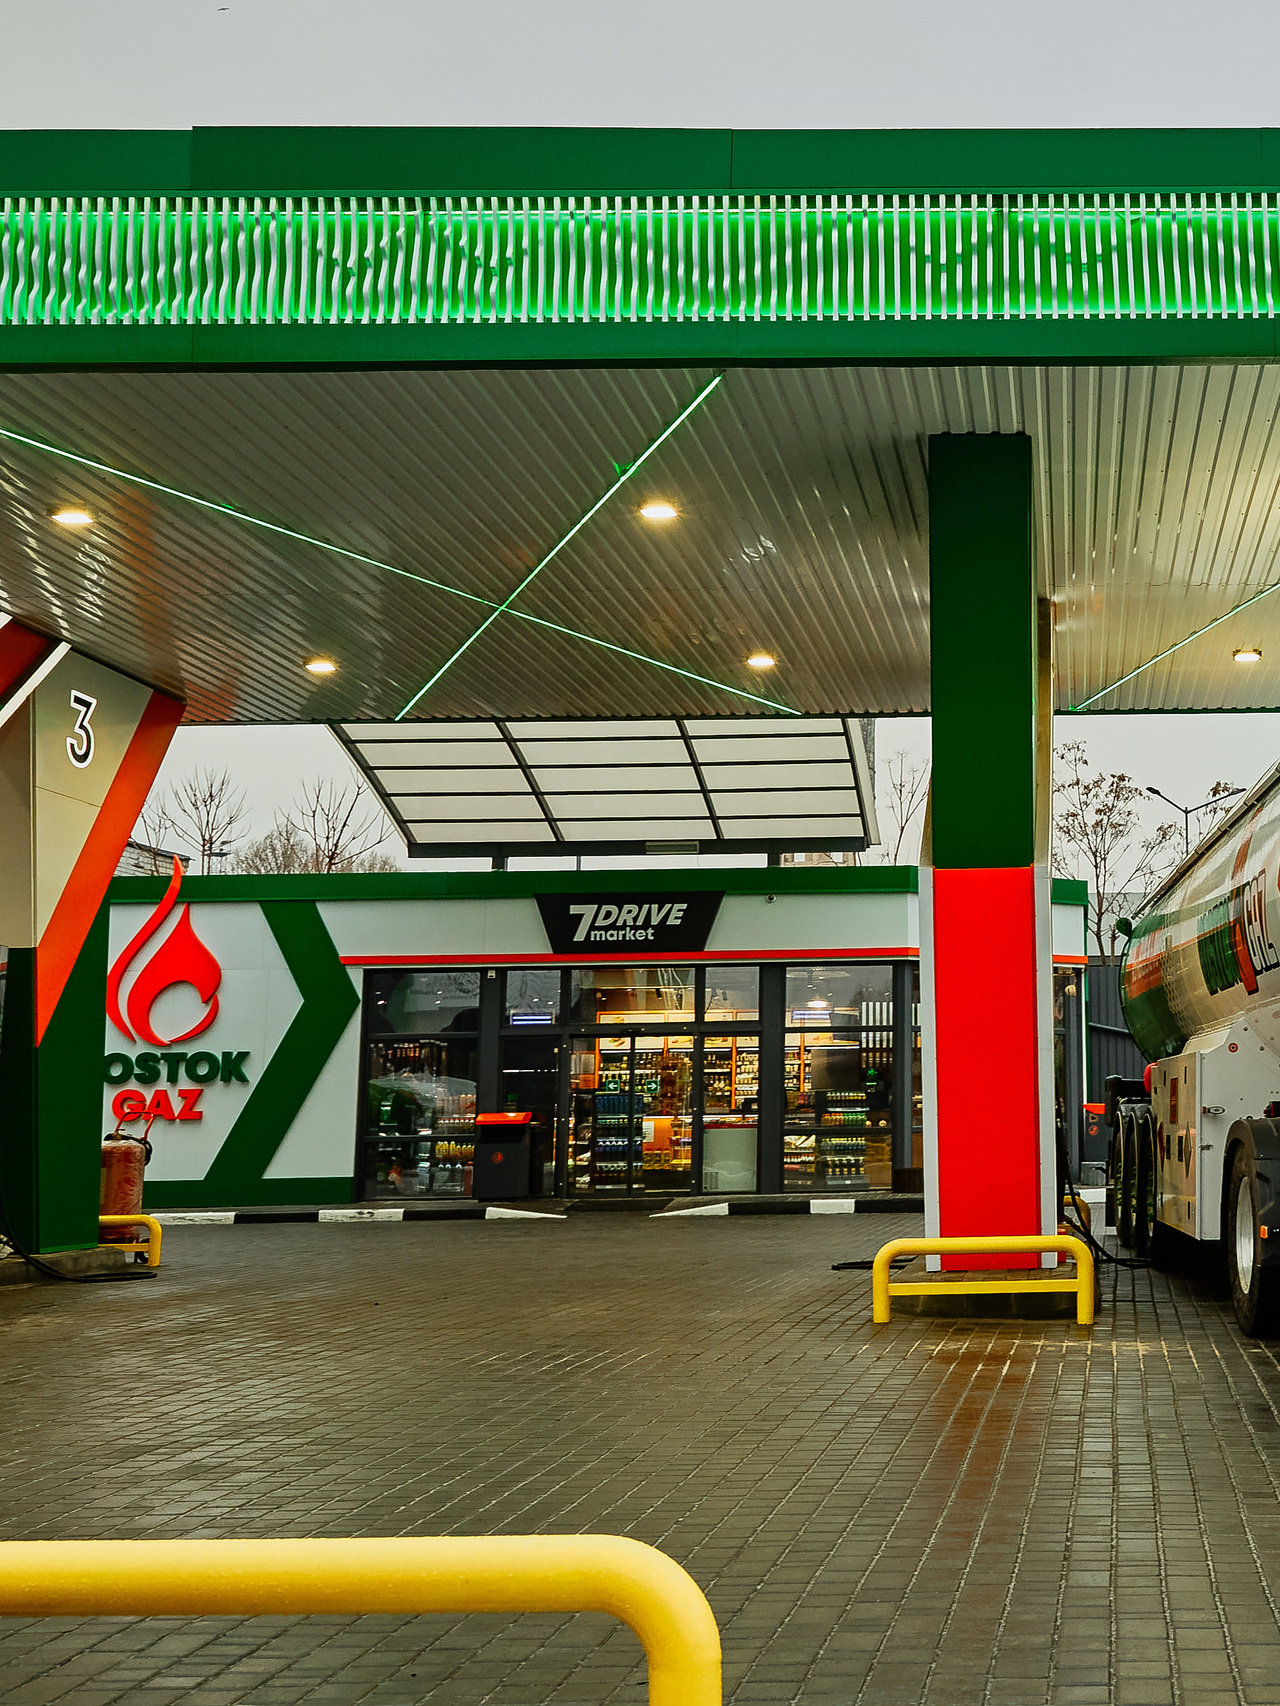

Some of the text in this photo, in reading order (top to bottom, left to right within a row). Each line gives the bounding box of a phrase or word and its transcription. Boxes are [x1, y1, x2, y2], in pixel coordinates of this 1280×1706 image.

[66, 689, 98, 769] 3
[590, 926, 655, 941] market
[103, 1050, 251, 1085] OSTOK
[111, 1088, 204, 1122] GAZ
